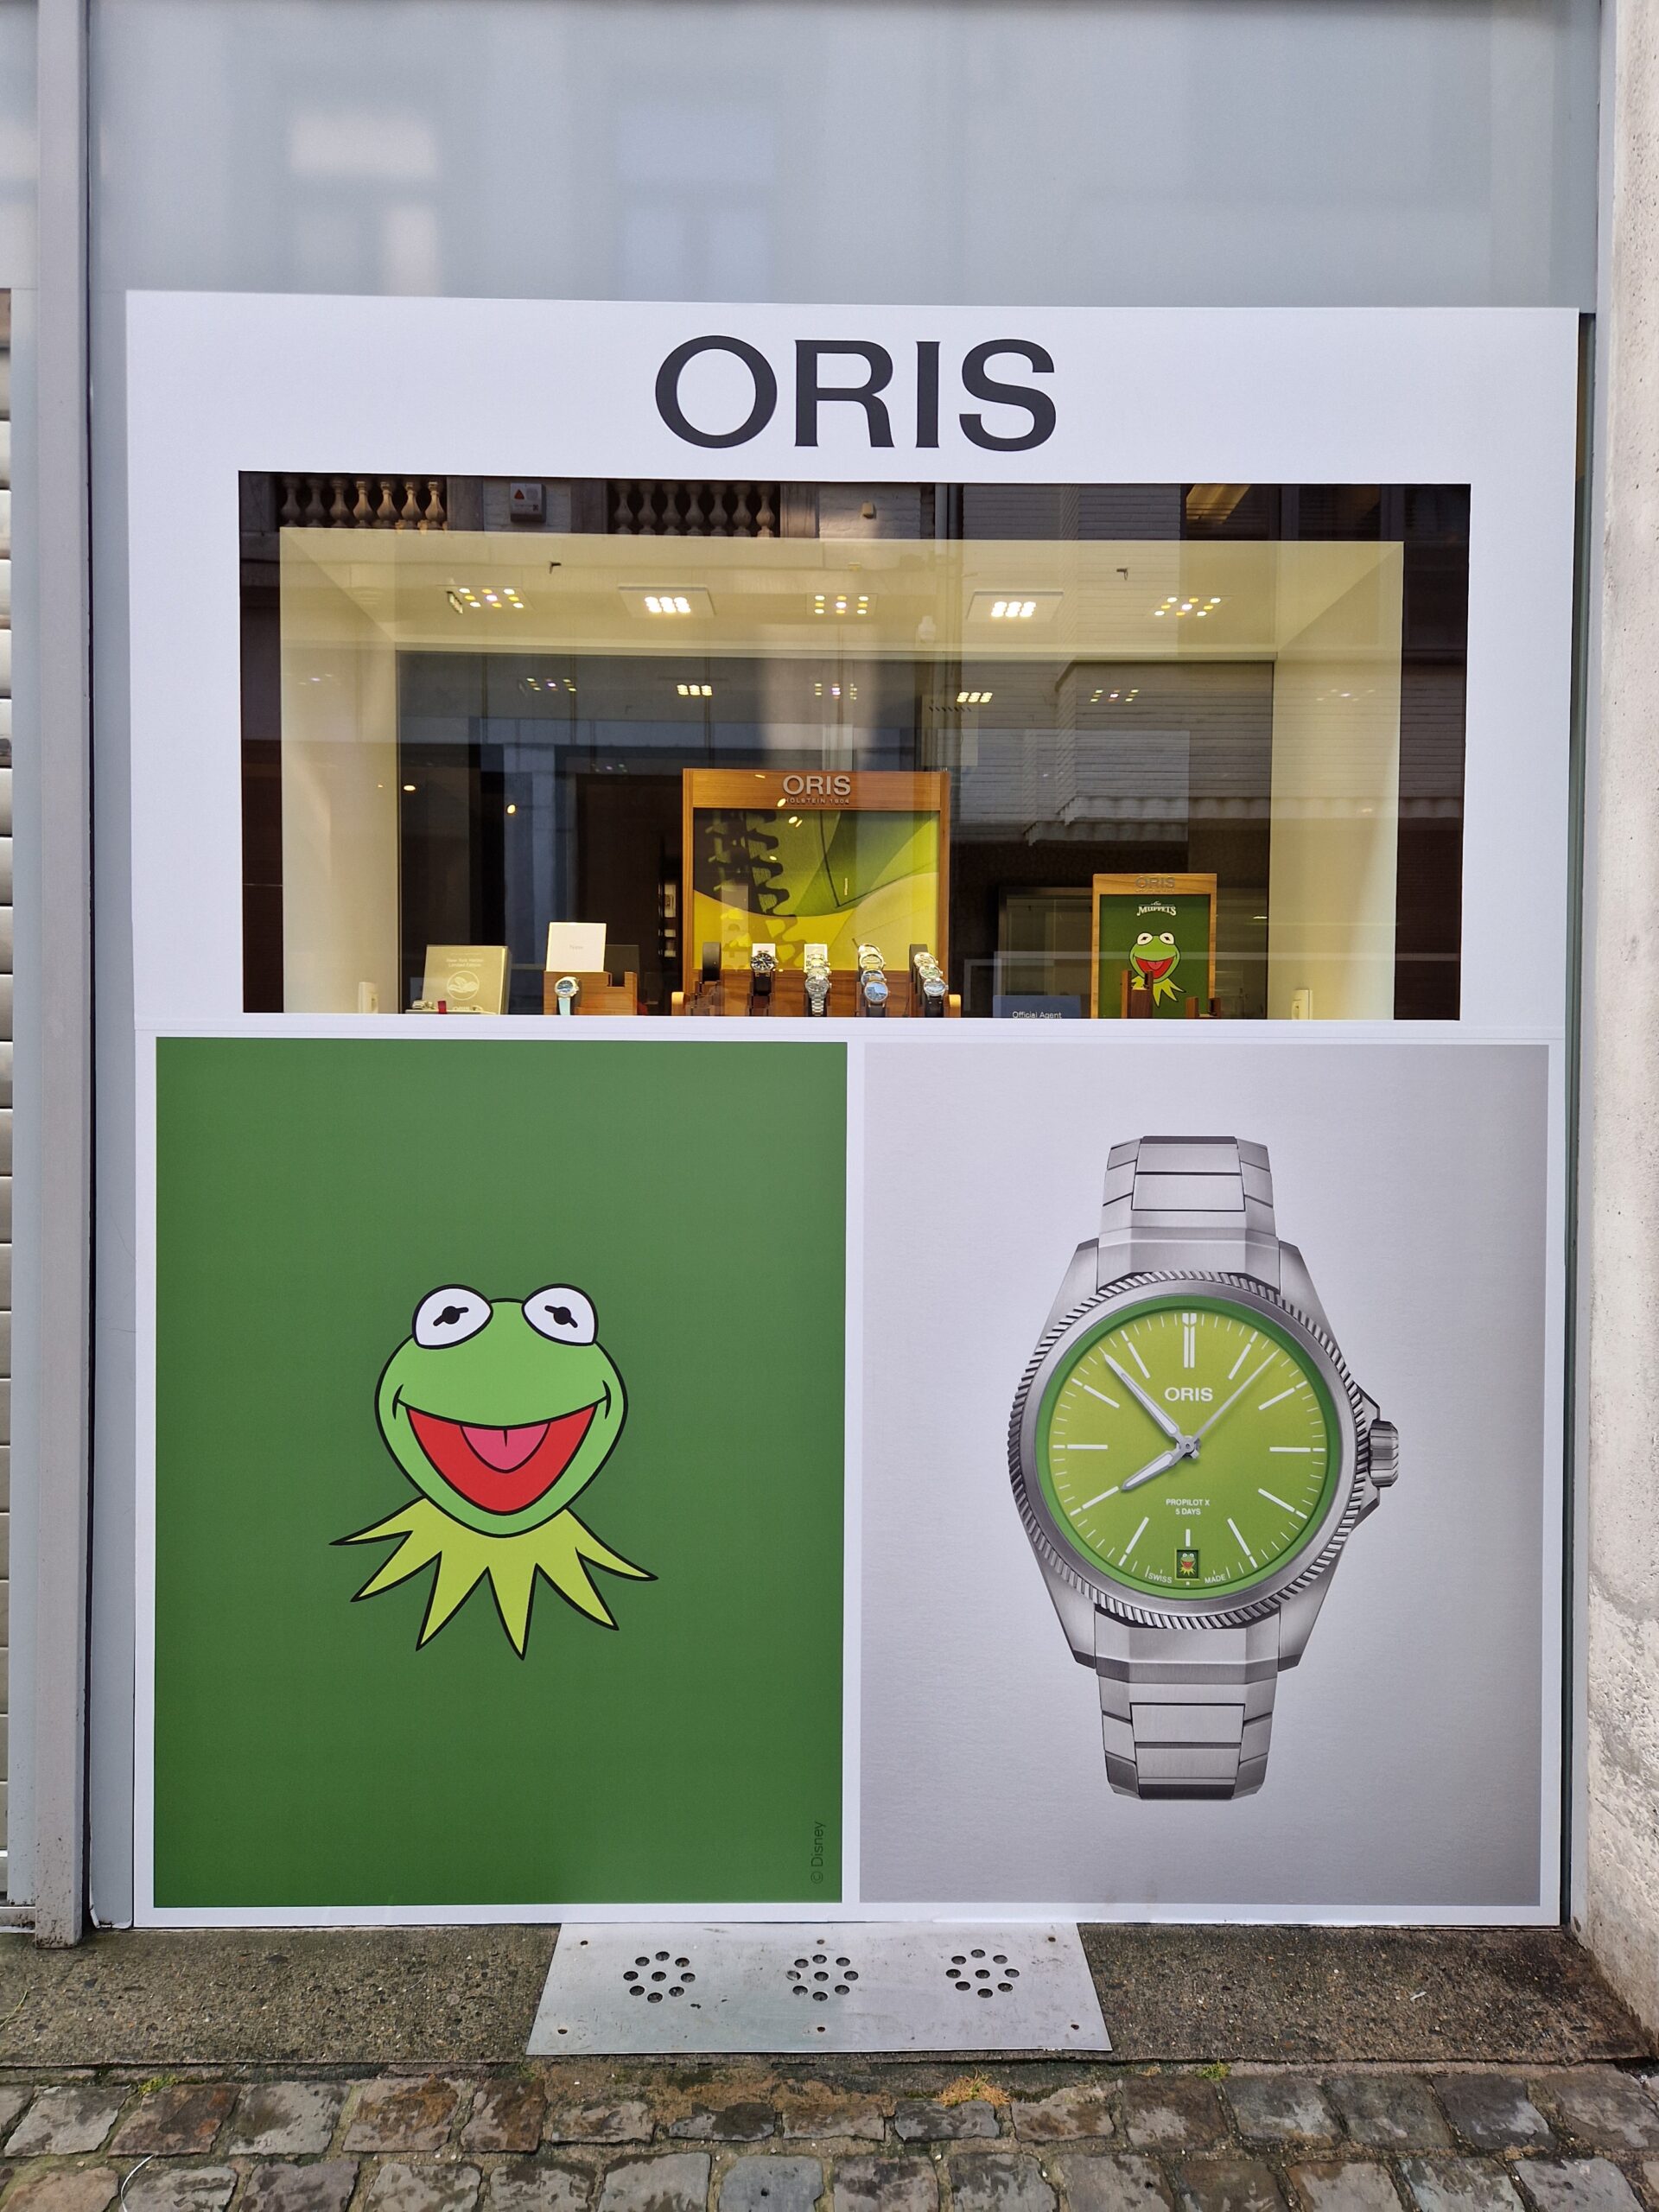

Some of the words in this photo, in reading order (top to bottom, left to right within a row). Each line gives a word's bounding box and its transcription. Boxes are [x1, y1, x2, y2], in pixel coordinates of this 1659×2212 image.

[655, 334, 1057, 452] ORIS
[783, 774, 851, 796] ORIS
[1135, 876, 1176, 889] ORIS
[1136, 906, 1177, 917] MUPPETS
[1164, 1387, 1213, 1402] ORIS
[1147, 1573, 1173, 1584] SWISS
[1205, 1573, 1227, 1584] MADE
[810, 1820, 827, 1867] Disney
